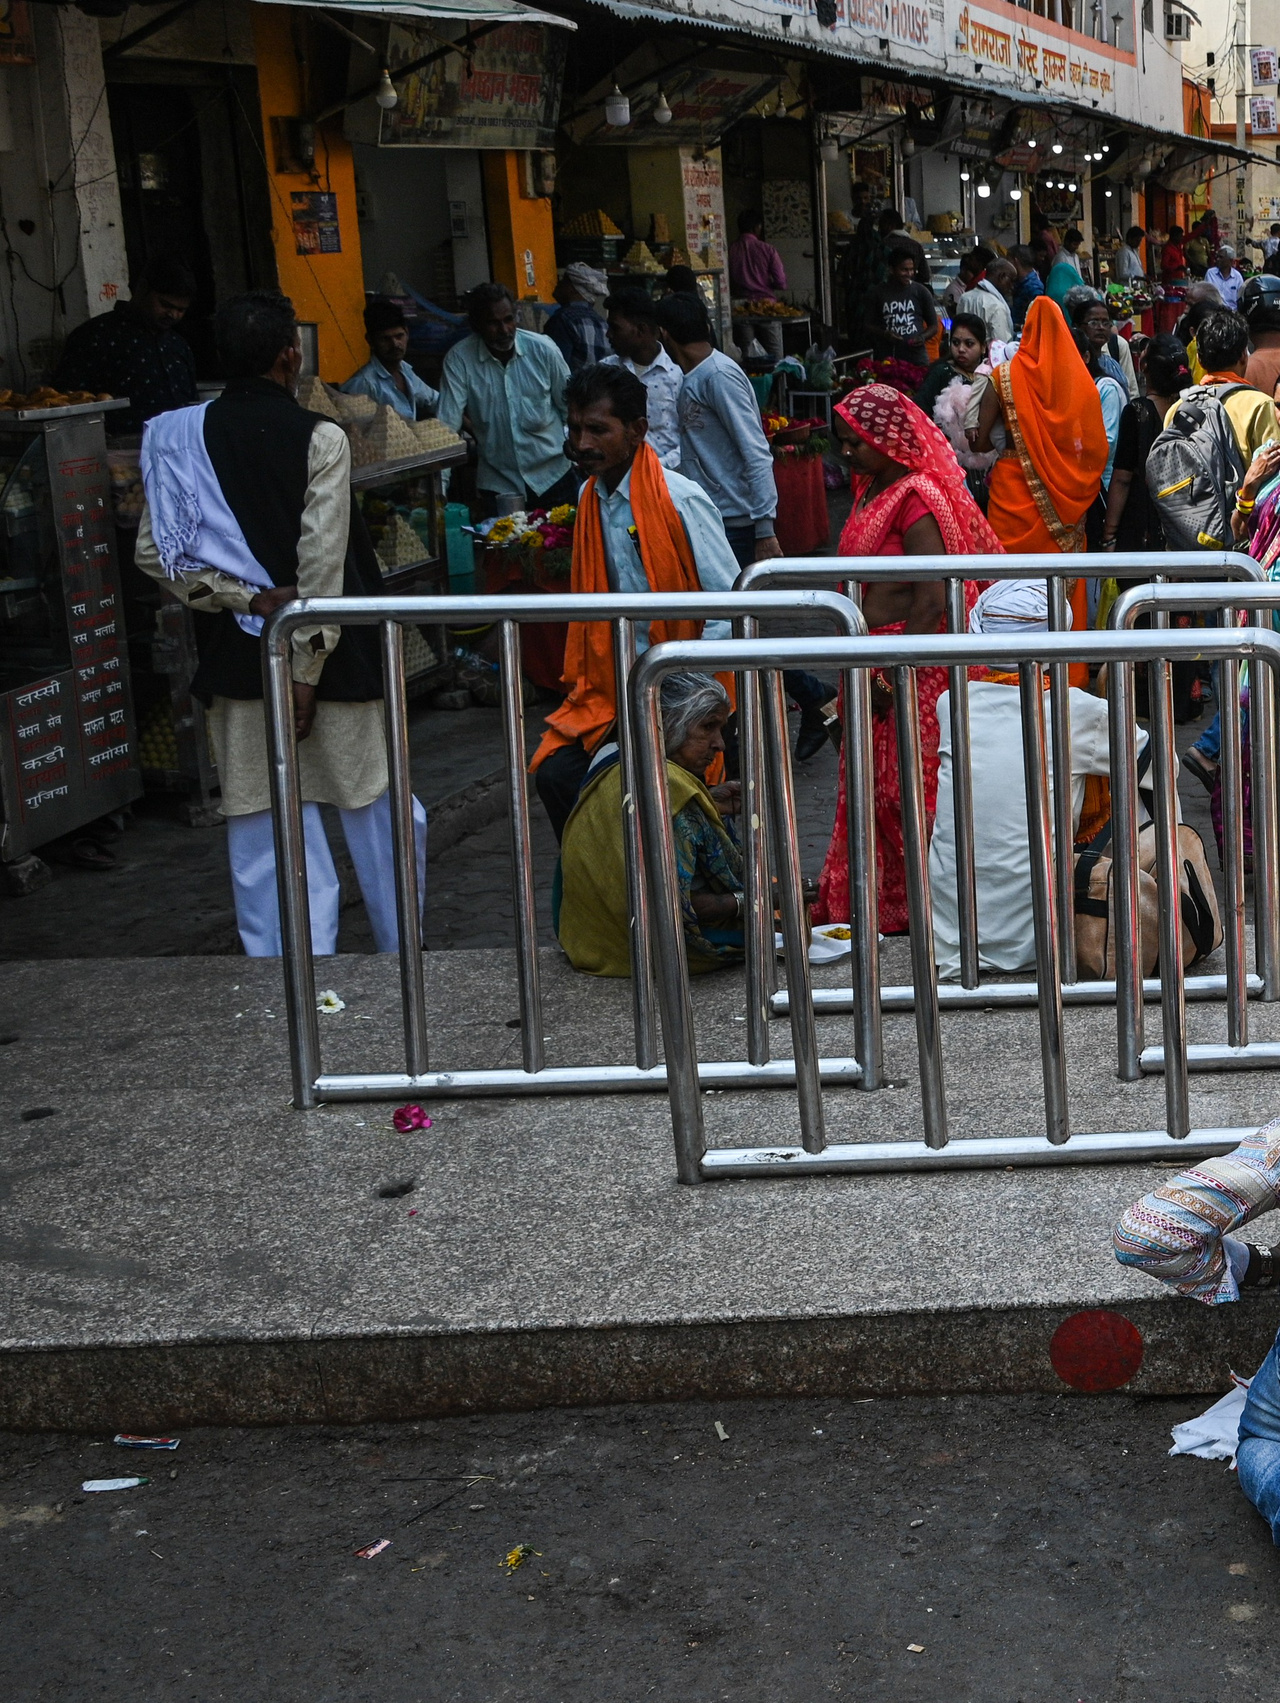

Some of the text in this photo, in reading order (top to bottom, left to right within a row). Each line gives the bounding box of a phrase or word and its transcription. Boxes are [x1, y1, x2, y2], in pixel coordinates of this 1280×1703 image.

[890, 3, 928, 44] House
[970, 20, 1011, 67] रामराजा
[882, 299, 915, 313] APNA
[71, 603, 86, 616] रस
[73, 620, 116, 645] रस मलाई
[79, 666, 96, 681] दूध
[103, 657, 120, 671] दही
[16, 680, 61, 707] लस्सी
[81, 689, 102, 703] अमूल
[17, 714, 62, 739] बेसन सेव
[83, 709, 126, 736] सफल मटर
[22, 745, 66, 770] कडी
[89, 742, 130, 766] समोसा
[25, 785, 69, 810] गुजिया
